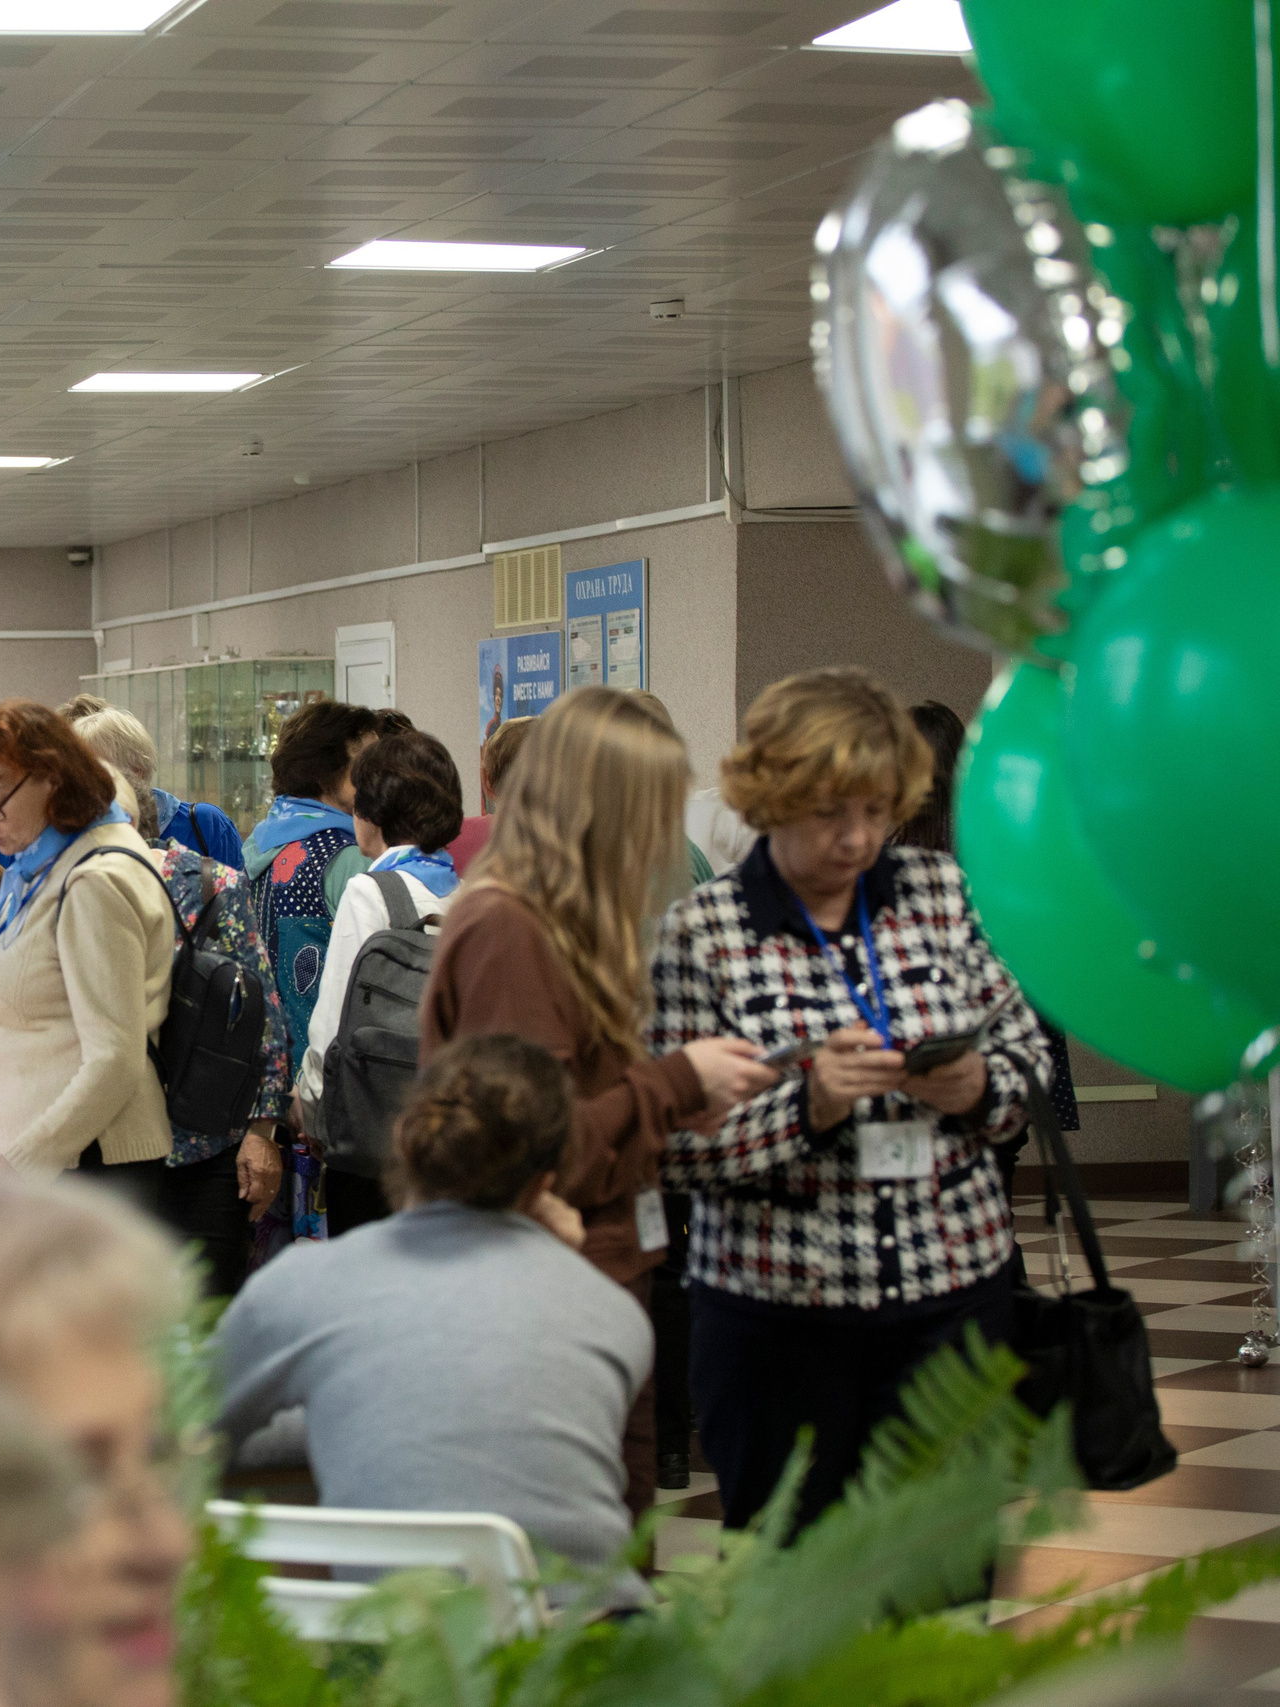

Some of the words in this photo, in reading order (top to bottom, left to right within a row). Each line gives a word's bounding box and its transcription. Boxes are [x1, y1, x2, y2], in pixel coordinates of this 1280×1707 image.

[575, 578, 606, 600] ОХРАНА
[608, 573, 633, 595] ТРУДА
[517, 649, 550, 673] РАЗВИВАЙСЯ
[513, 682, 532, 701] ВМЕСТЕ
[533, 682, 537, 699] С
